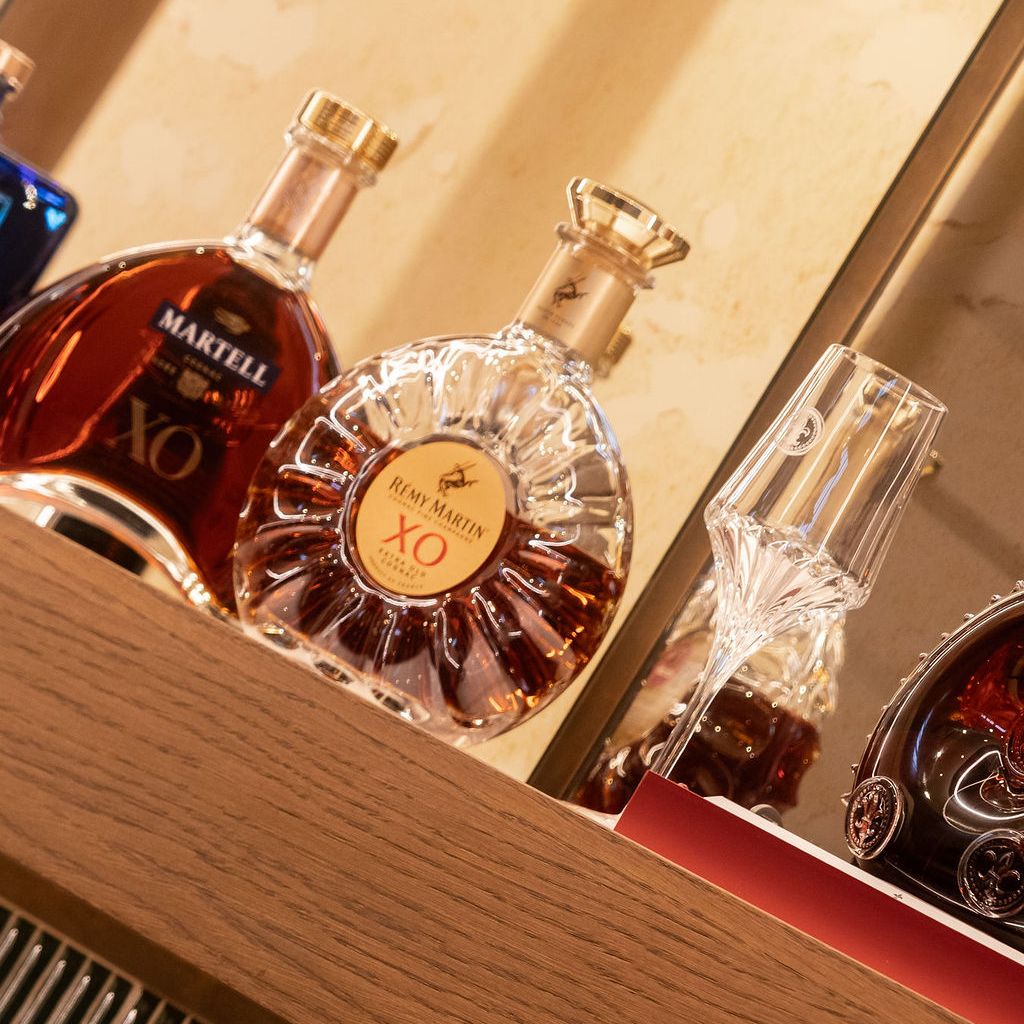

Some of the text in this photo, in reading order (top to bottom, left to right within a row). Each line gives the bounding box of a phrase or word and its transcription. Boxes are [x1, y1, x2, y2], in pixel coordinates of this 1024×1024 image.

[158, 308, 268, 388] MARTELL
[105, 396, 203, 480] XO
[381, 513, 448, 567] XO
[429, 499, 486, 540] MARTIN
